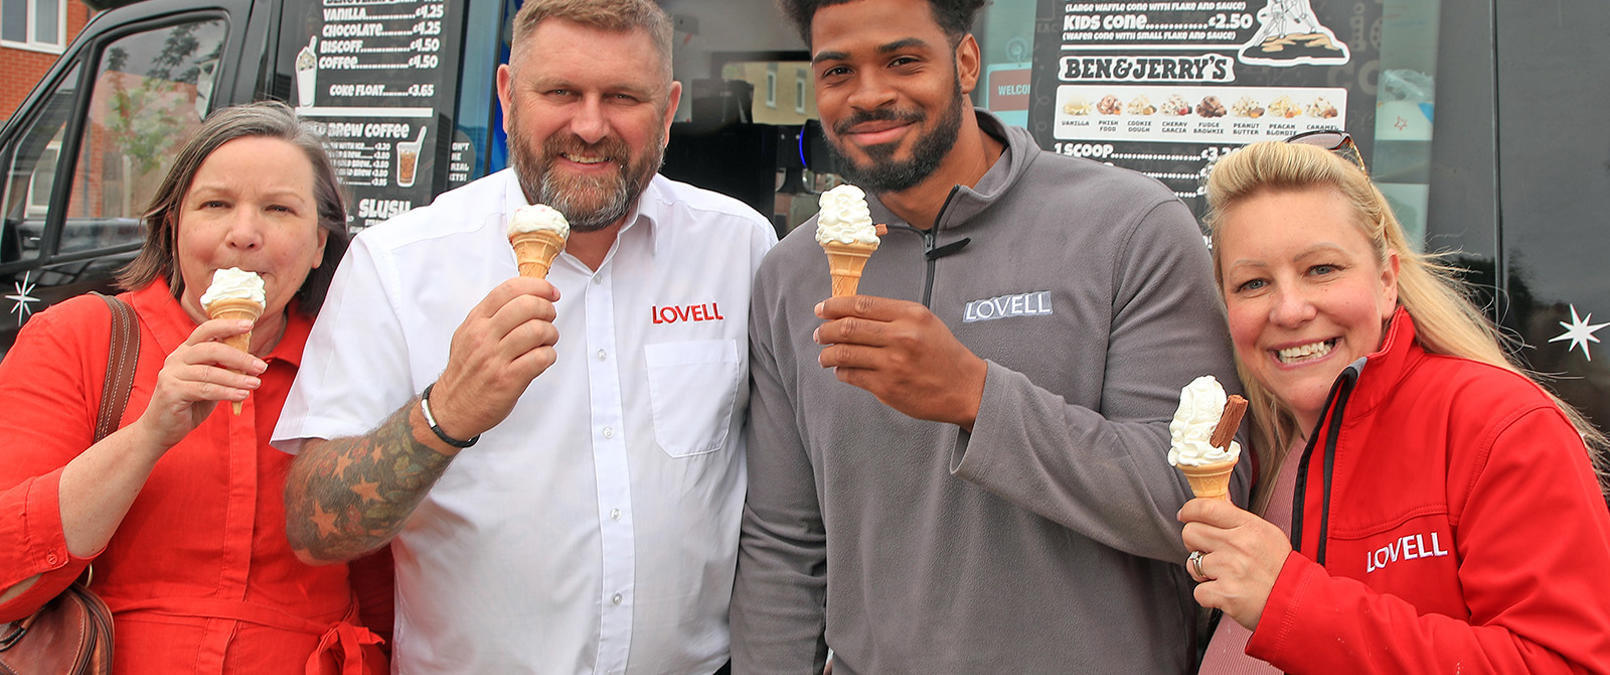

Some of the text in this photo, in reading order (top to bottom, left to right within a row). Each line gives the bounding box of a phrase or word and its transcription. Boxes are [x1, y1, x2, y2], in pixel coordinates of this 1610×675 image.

[323, 7, 366, 21] VANILLA
[1065, 3, 1094, 12] (LARGE
[1094, 3, 1125, 12] WAFFLE
[1149, 2, 1170, 11] WITH
[1171, 2, 1196, 11] FLAKE
[1197, 2, 1215, 10] AND
[1215, 2, 1246, 11] SAUCE)
[322, 22, 383, 37] CHOCOLATE
[1063, 14, 1101, 31] KIDS
[1062, 32, 1093, 41] (WAFER
[1115, 32, 1136, 40] WITH
[1136, 31, 1163, 40] SMALL
[1163, 31, 1188, 40] FLAKE
[1188, 31, 1206, 40] AND
[1206, 31, 1236, 41] SAUCE)
[320, 40, 363, 53] BISCOFF
[318, 56, 358, 69] COFFEE
[329, 84, 355, 96] COKE
[355, 84, 385, 96] FLOAT
[327, 122, 364, 137] BREW
[364, 123, 410, 138] COFFEE
[1053, 142, 1062, 155] 1
[1063, 143, 1115, 158] SCOOP
[652, 303, 724, 324] LOVELL
[966, 293, 1051, 321] LOVELL
[1366, 532, 1448, 573] LOVELL
